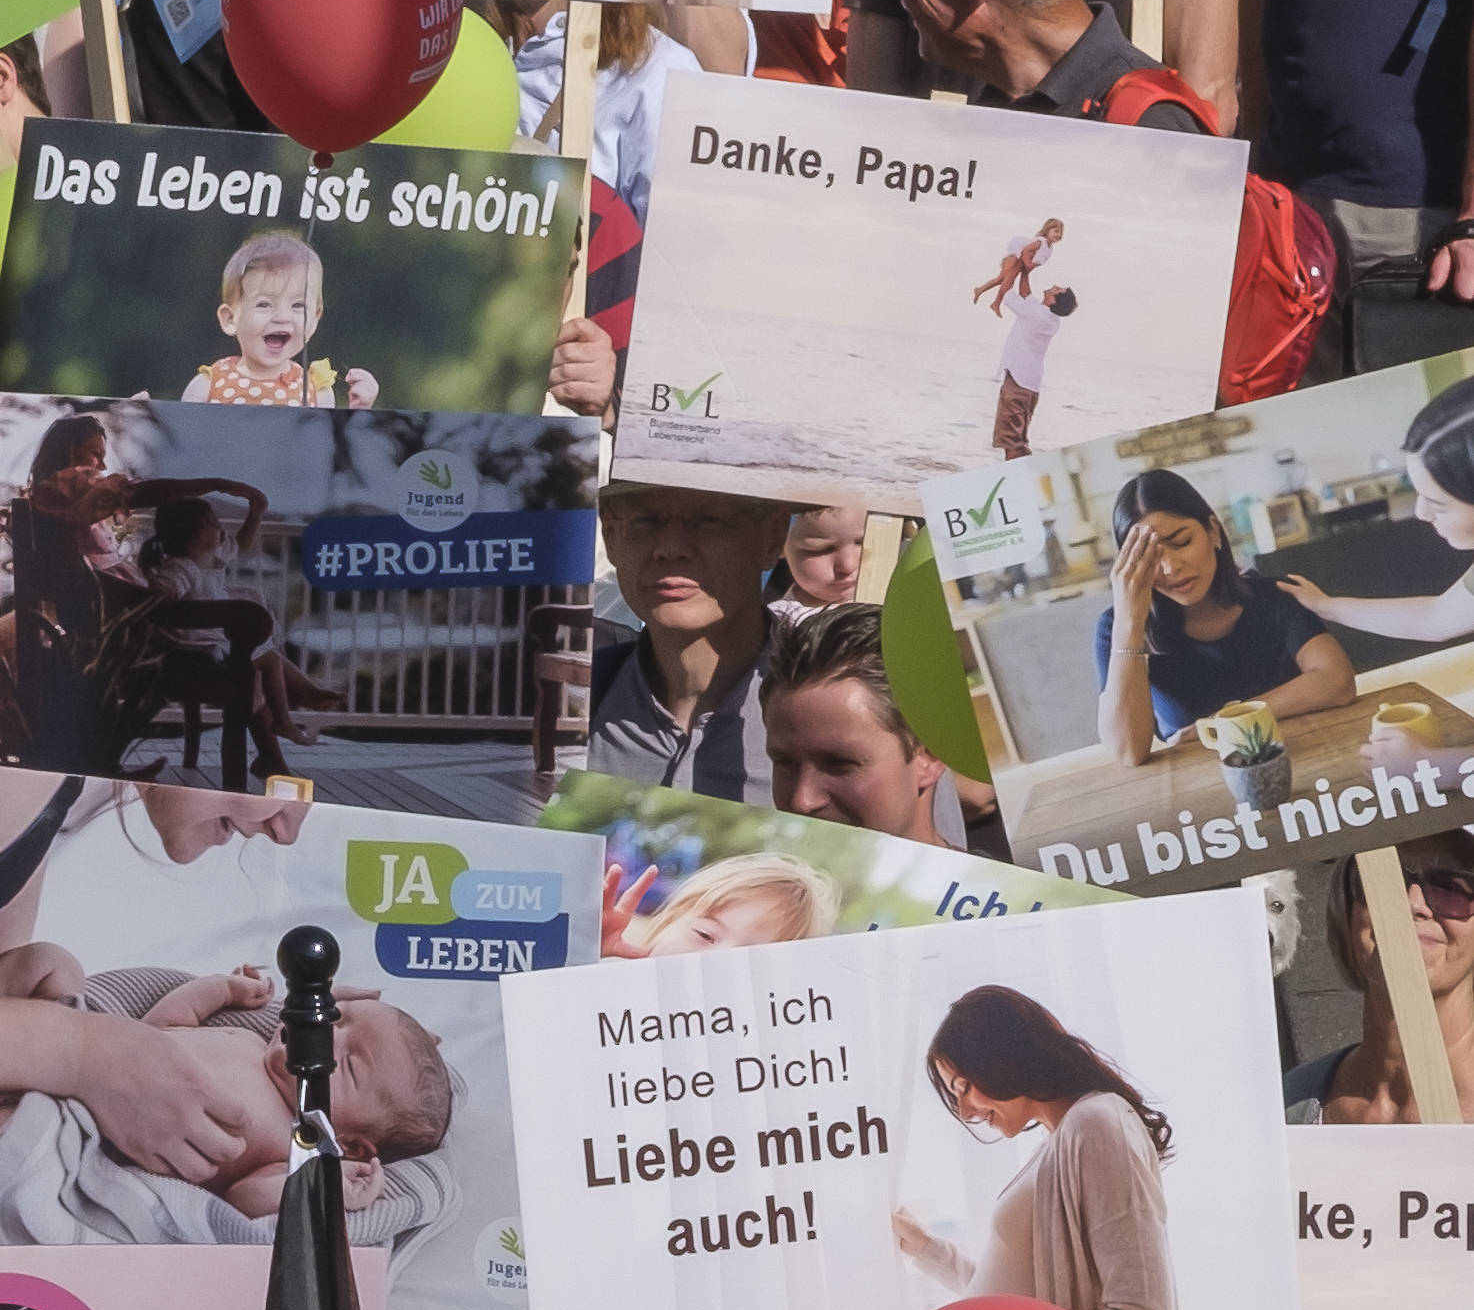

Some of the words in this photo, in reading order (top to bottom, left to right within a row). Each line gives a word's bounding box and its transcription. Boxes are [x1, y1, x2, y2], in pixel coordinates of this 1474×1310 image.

[34, 144, 117, 208] Das
[137, 153, 279, 218] Leben
[300, 163, 369, 224] ist
[389, 173, 558, 237] schön!
[690, 124, 837, 189] Danke,
[854, 146, 976, 203] Papa!
[406, 491, 465, 509] Jugend
[315, 538, 534, 580] #PROLIFE
[375, 852, 440, 912] JA
[476, 885, 542, 911] ZUM
[406, 938, 535, 974] LEBEN
[599, 1001, 749, 1050] Mama,
[769, 987, 834, 1029] ich
[607, 1064, 715, 1109] liebe
[737, 1046, 850, 1095] Dich!
[583, 1129, 736, 1189] Liebe
[758, 1105, 889, 1169] mich
[667, 1191, 818, 1255] auch!
